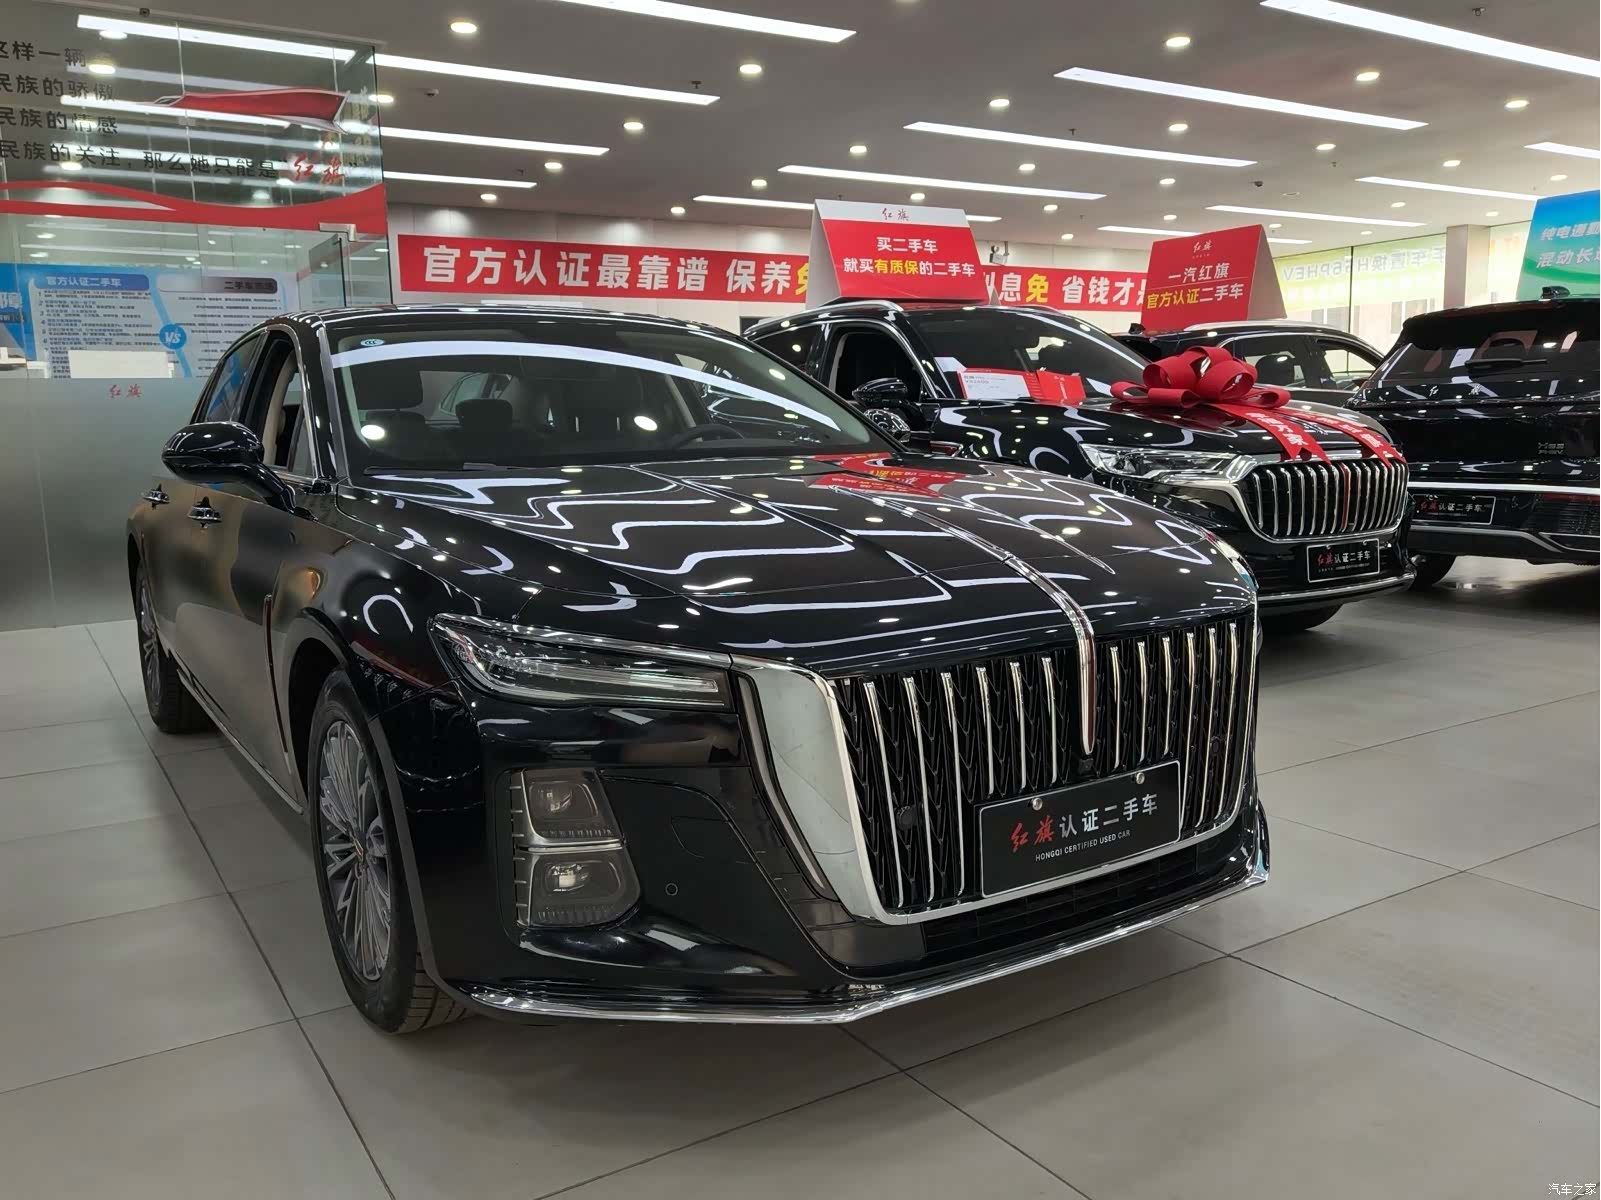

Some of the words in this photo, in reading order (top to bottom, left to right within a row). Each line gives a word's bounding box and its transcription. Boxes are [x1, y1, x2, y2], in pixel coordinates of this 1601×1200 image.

[876, 236, 939, 254] 买二手车
[423, 244, 709, 293] 官方认证最靠谱
[843, 257, 977, 278] 就买有质保的二手车
[1167, 262, 1231, 284] 一汽红旗
[46, 275, 122, 287] 官方认证二手车
[1146, 282, 1245, 310] 官方认证二手车
[165, 330, 182, 345] VS
[1010, 793, 1158, 853] 红旗认证二手车
[1035, 848, 1063, 862] HONGQI
[1064, 838, 1098, 854] CERTIFIED
[1099, 833, 1117, 845] USED
[1118, 829, 1131, 840] CAR
